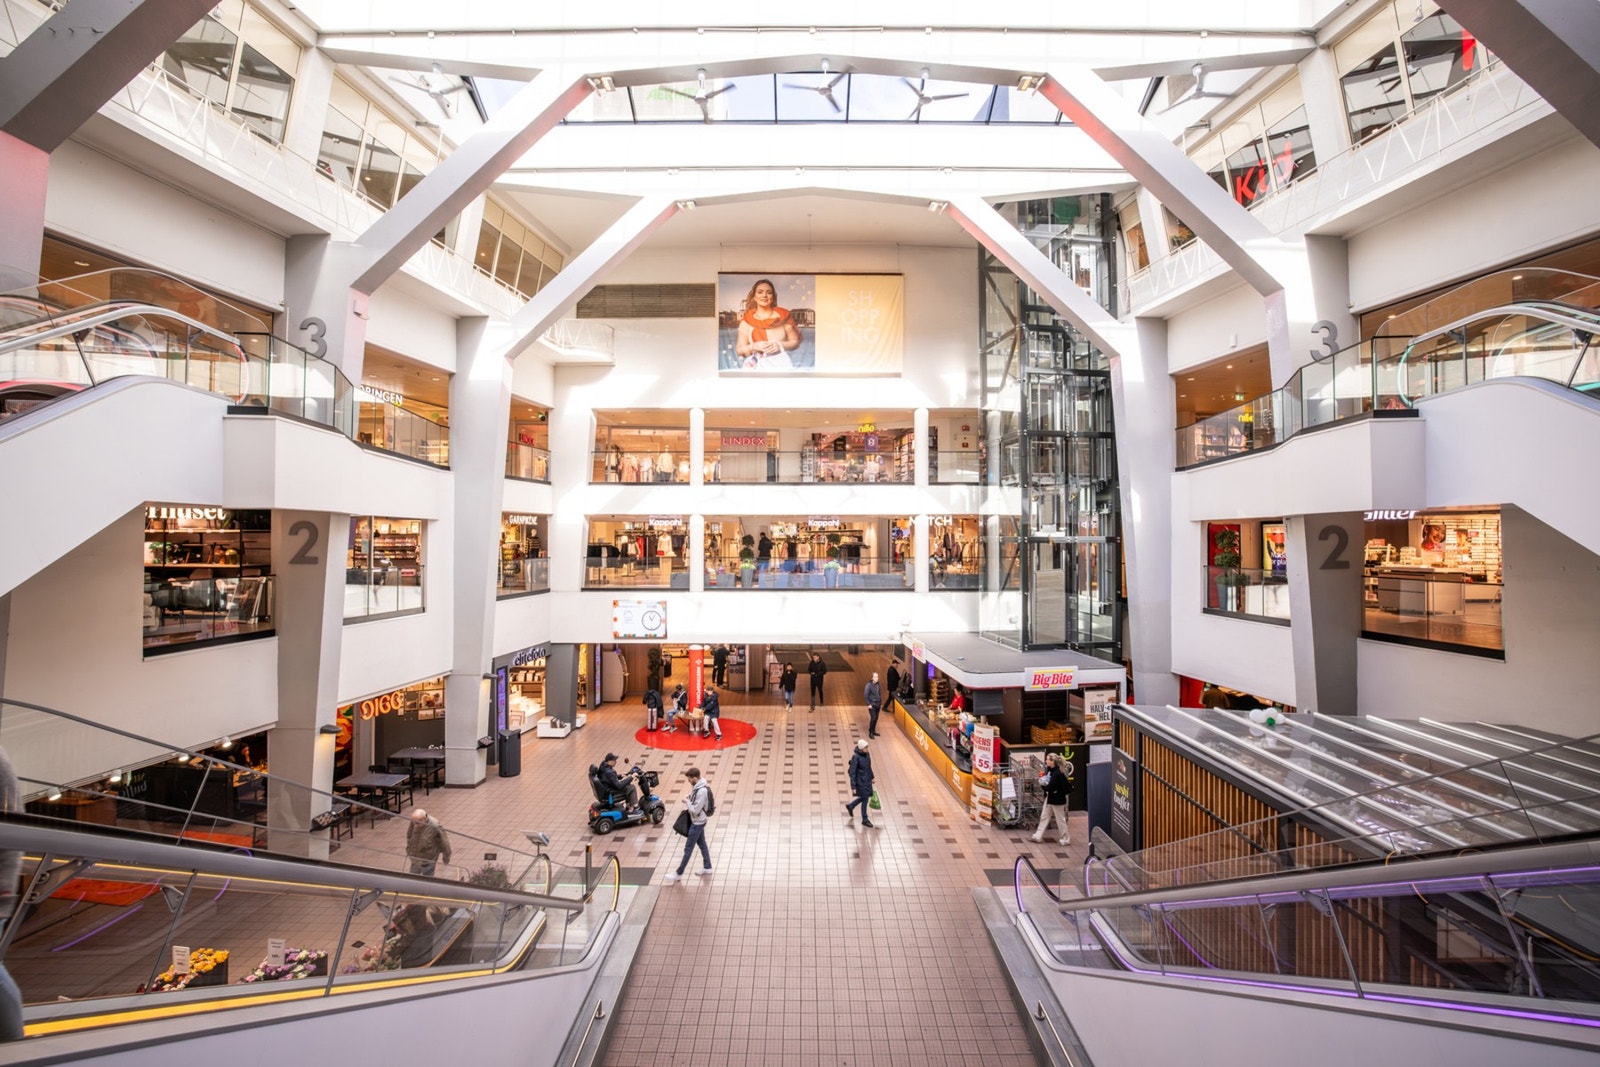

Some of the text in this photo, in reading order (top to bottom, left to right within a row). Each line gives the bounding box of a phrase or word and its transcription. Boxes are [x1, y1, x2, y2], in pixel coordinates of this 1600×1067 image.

[300, 317, 327, 361] 3
[1310, 320, 1339, 364] 3
[722, 437, 766, 446] LINDEX
[909, 515, 953, 526] MTCH
[288, 521, 319, 565] 2
[1318, 525, 1350, 570] 2
[513, 647, 547, 667] elitefoto
[1032, 672, 1073, 689] Big Bite
